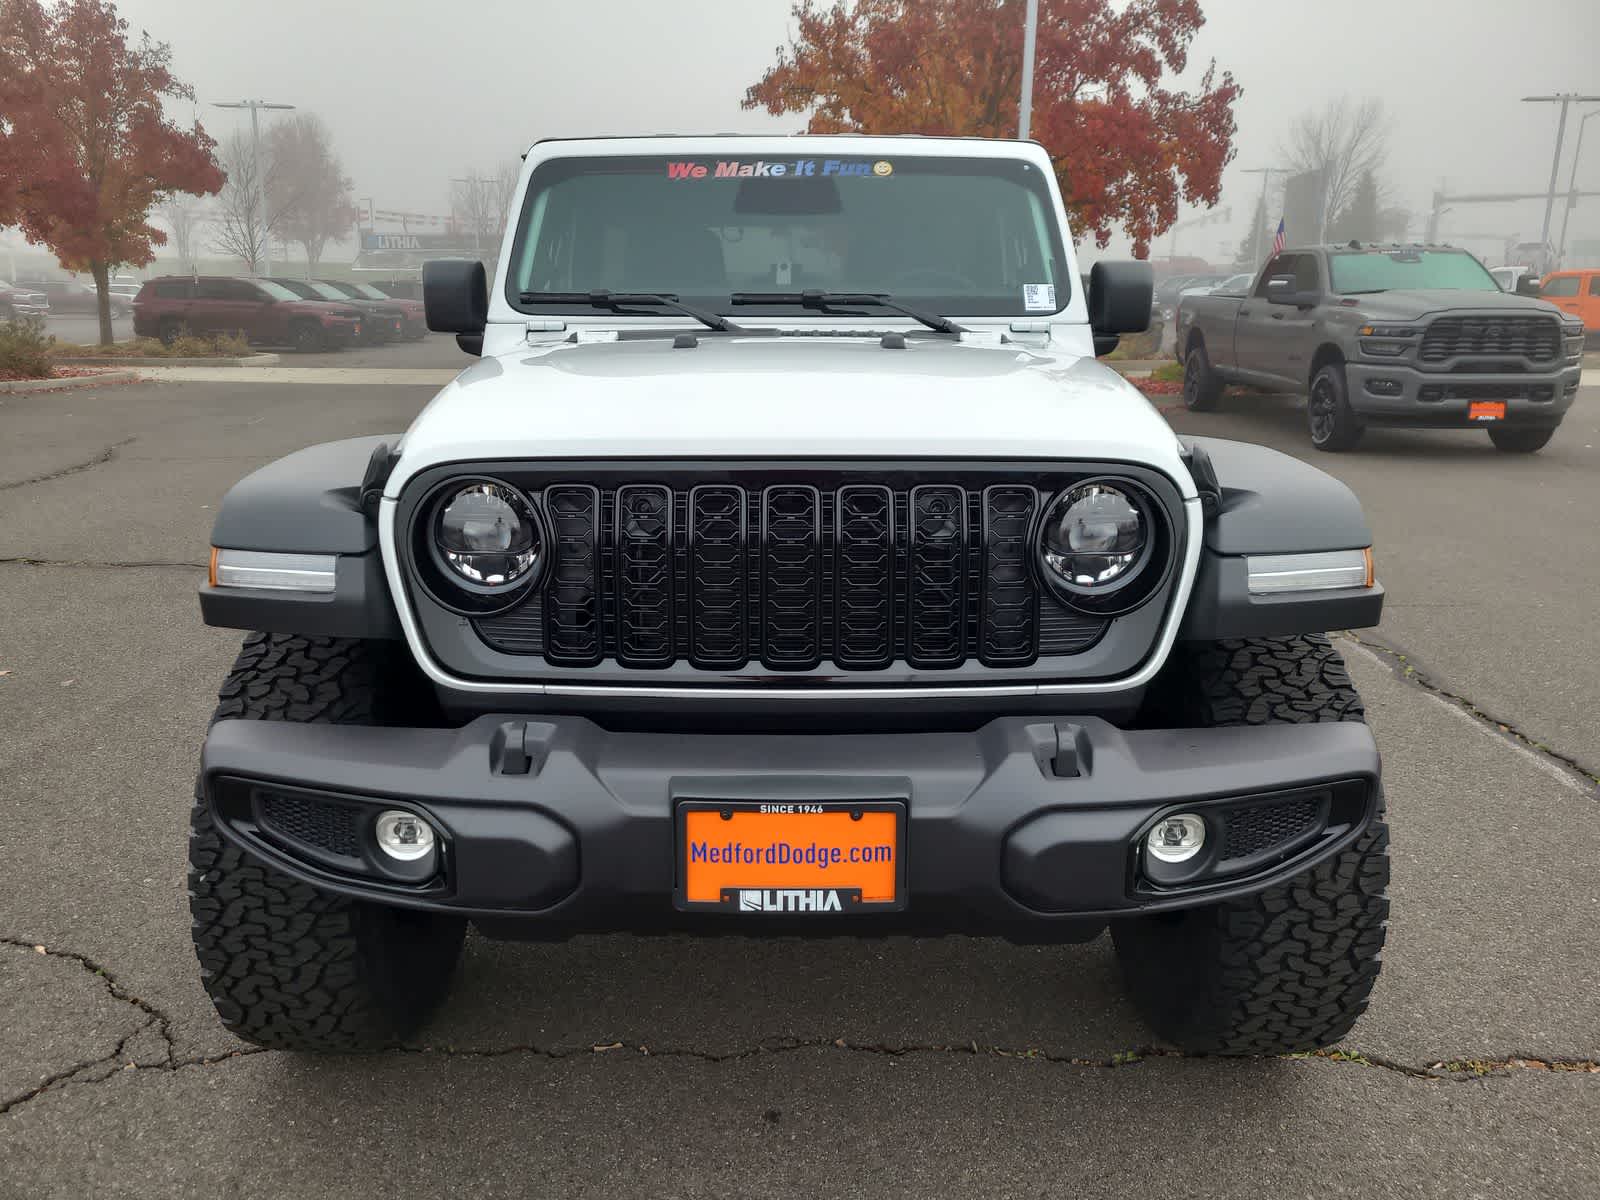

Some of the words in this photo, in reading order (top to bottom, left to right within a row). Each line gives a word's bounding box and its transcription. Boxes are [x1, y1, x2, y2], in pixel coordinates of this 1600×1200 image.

[667, 161, 708, 178] We
[714, 160, 787, 177] Make
[794, 160, 815, 177] It
[821, 160, 872, 177] Fun
[760, 805, 794, 814] SINCE
[798, 805, 824, 814] 1946
[690, 841, 893, 869] MedfordDodge.com
[763, 889, 842, 911] LITHIA
